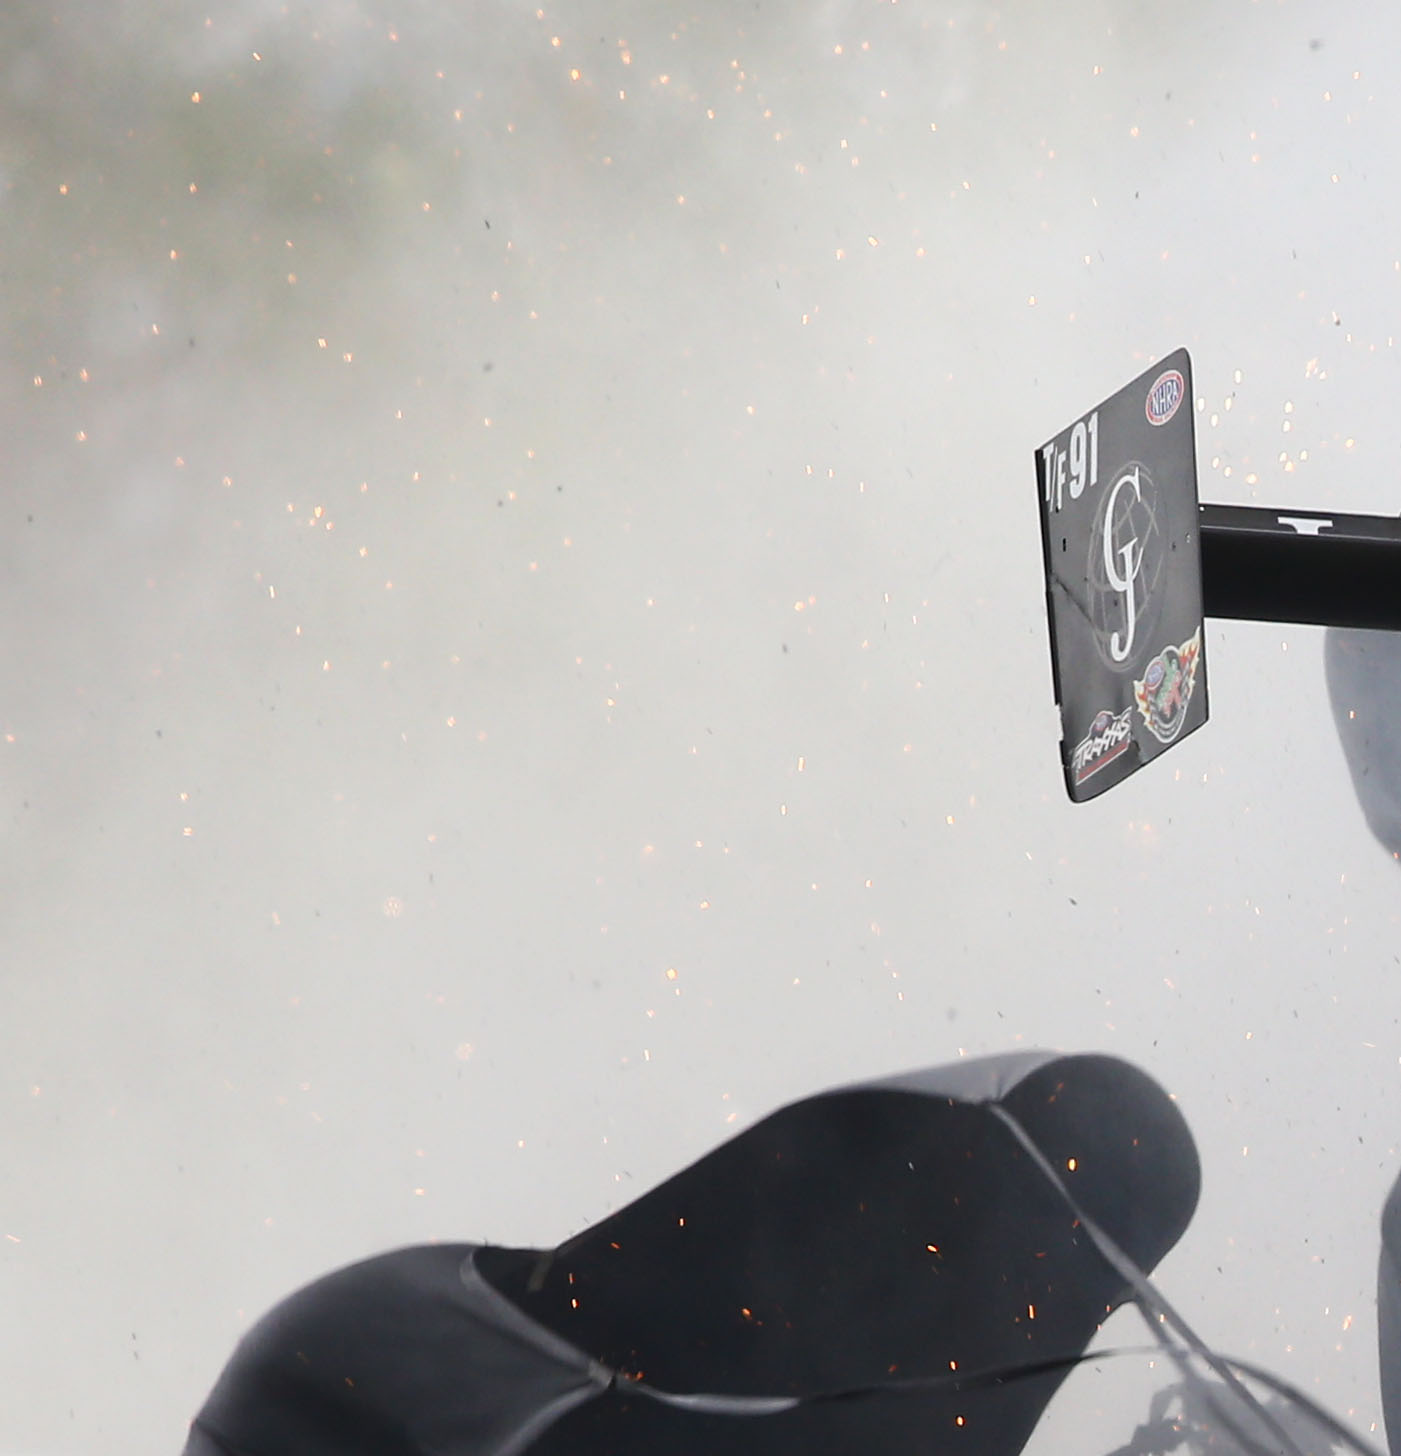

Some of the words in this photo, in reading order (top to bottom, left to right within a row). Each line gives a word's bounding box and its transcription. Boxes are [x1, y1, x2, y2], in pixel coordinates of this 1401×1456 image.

[1151, 380, 1179, 416] NHRA
[1042, 442, 1067, 513] T/F
[1069, 411, 1099, 500] 91
